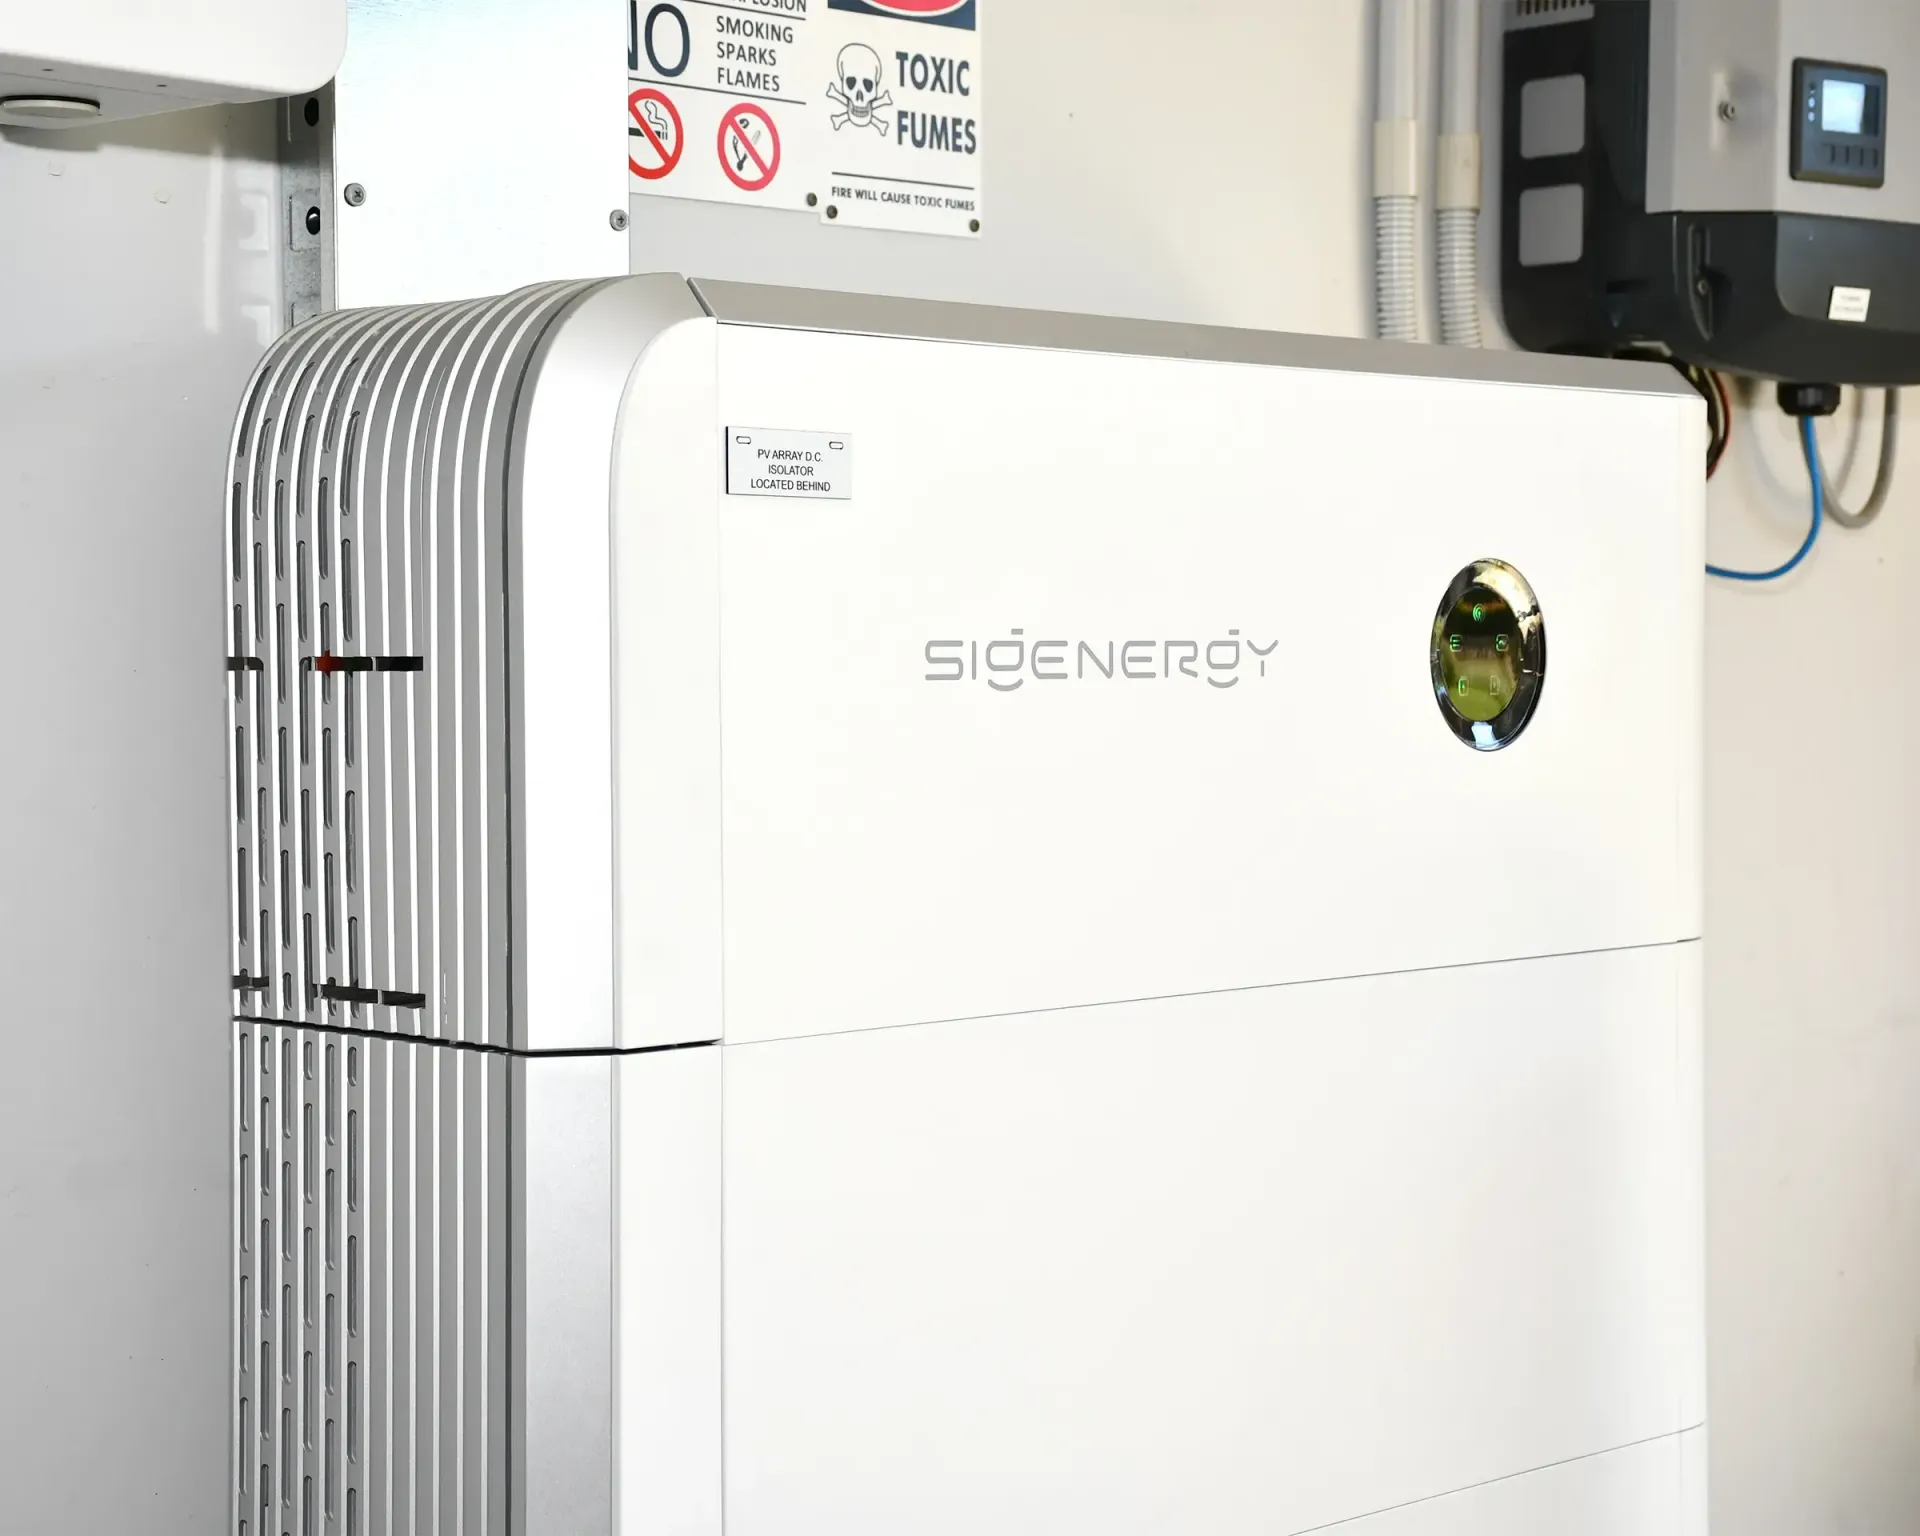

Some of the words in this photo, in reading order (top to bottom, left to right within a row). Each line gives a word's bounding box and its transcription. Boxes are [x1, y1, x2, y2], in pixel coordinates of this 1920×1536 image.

[716, 15, 794, 44] SMOKING
[716, 41, 777, 67] SPARKS
[717, 66, 781, 92] FLAMES
[895, 51, 970, 97] TOXIC
[897, 110, 977, 155] FUMES
[831, 186, 852, 199] FIRE
[855, 188, 878, 201] WILL
[881, 191, 912, 205] CAUSE
[914, 195, 943, 208] TOXIC
[945, 198, 975, 212] FUMES
[757, 448, 771, 459] PV
[771, 450, 803, 461] ARRAY
[805, 451, 824, 462] D.C.
[768, 464, 814, 477] ISOLATOR
[750, 478, 794, 491] LOCATED
[796, 480, 831, 492] BEHIND
